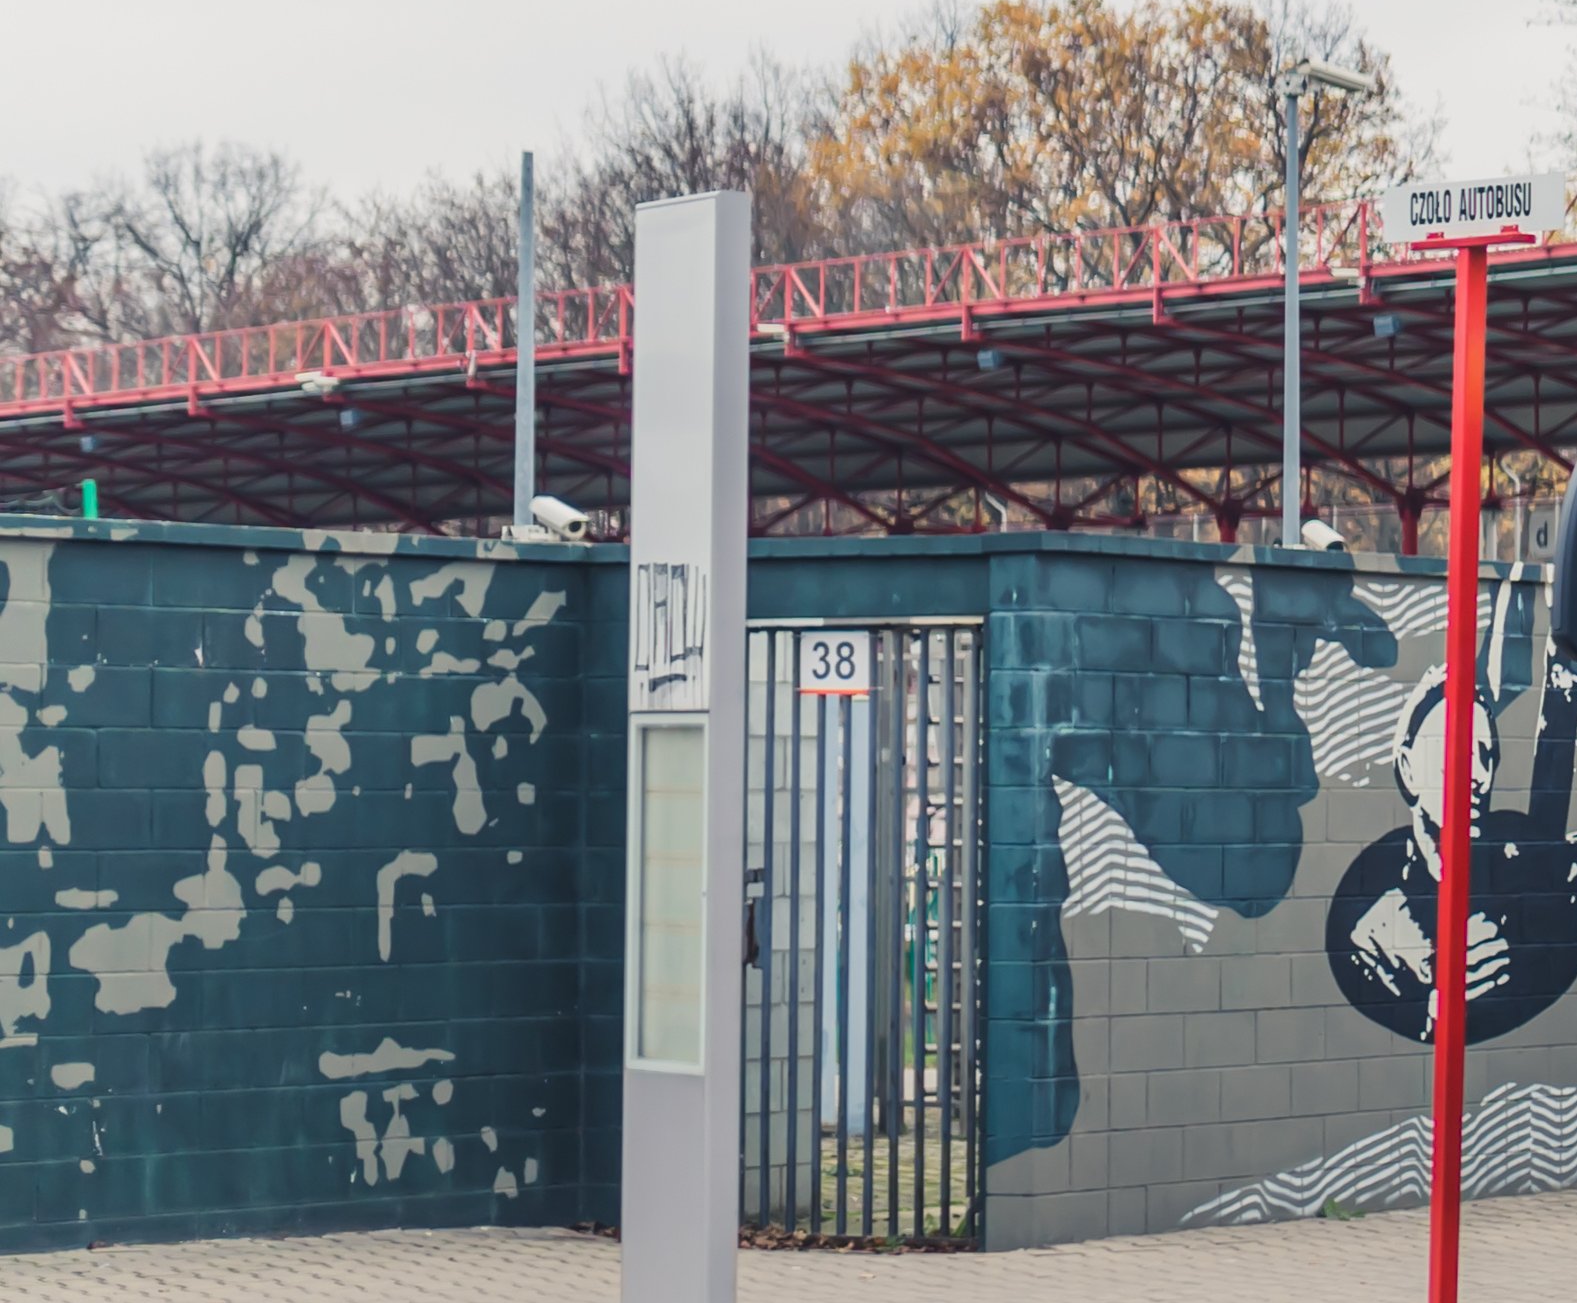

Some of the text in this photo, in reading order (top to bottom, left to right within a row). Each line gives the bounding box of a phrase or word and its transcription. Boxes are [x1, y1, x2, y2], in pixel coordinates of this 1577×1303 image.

[1410, 182, 1532, 226] CZOŁO AUTOBUSU
[812, 641, 855, 680] 38
